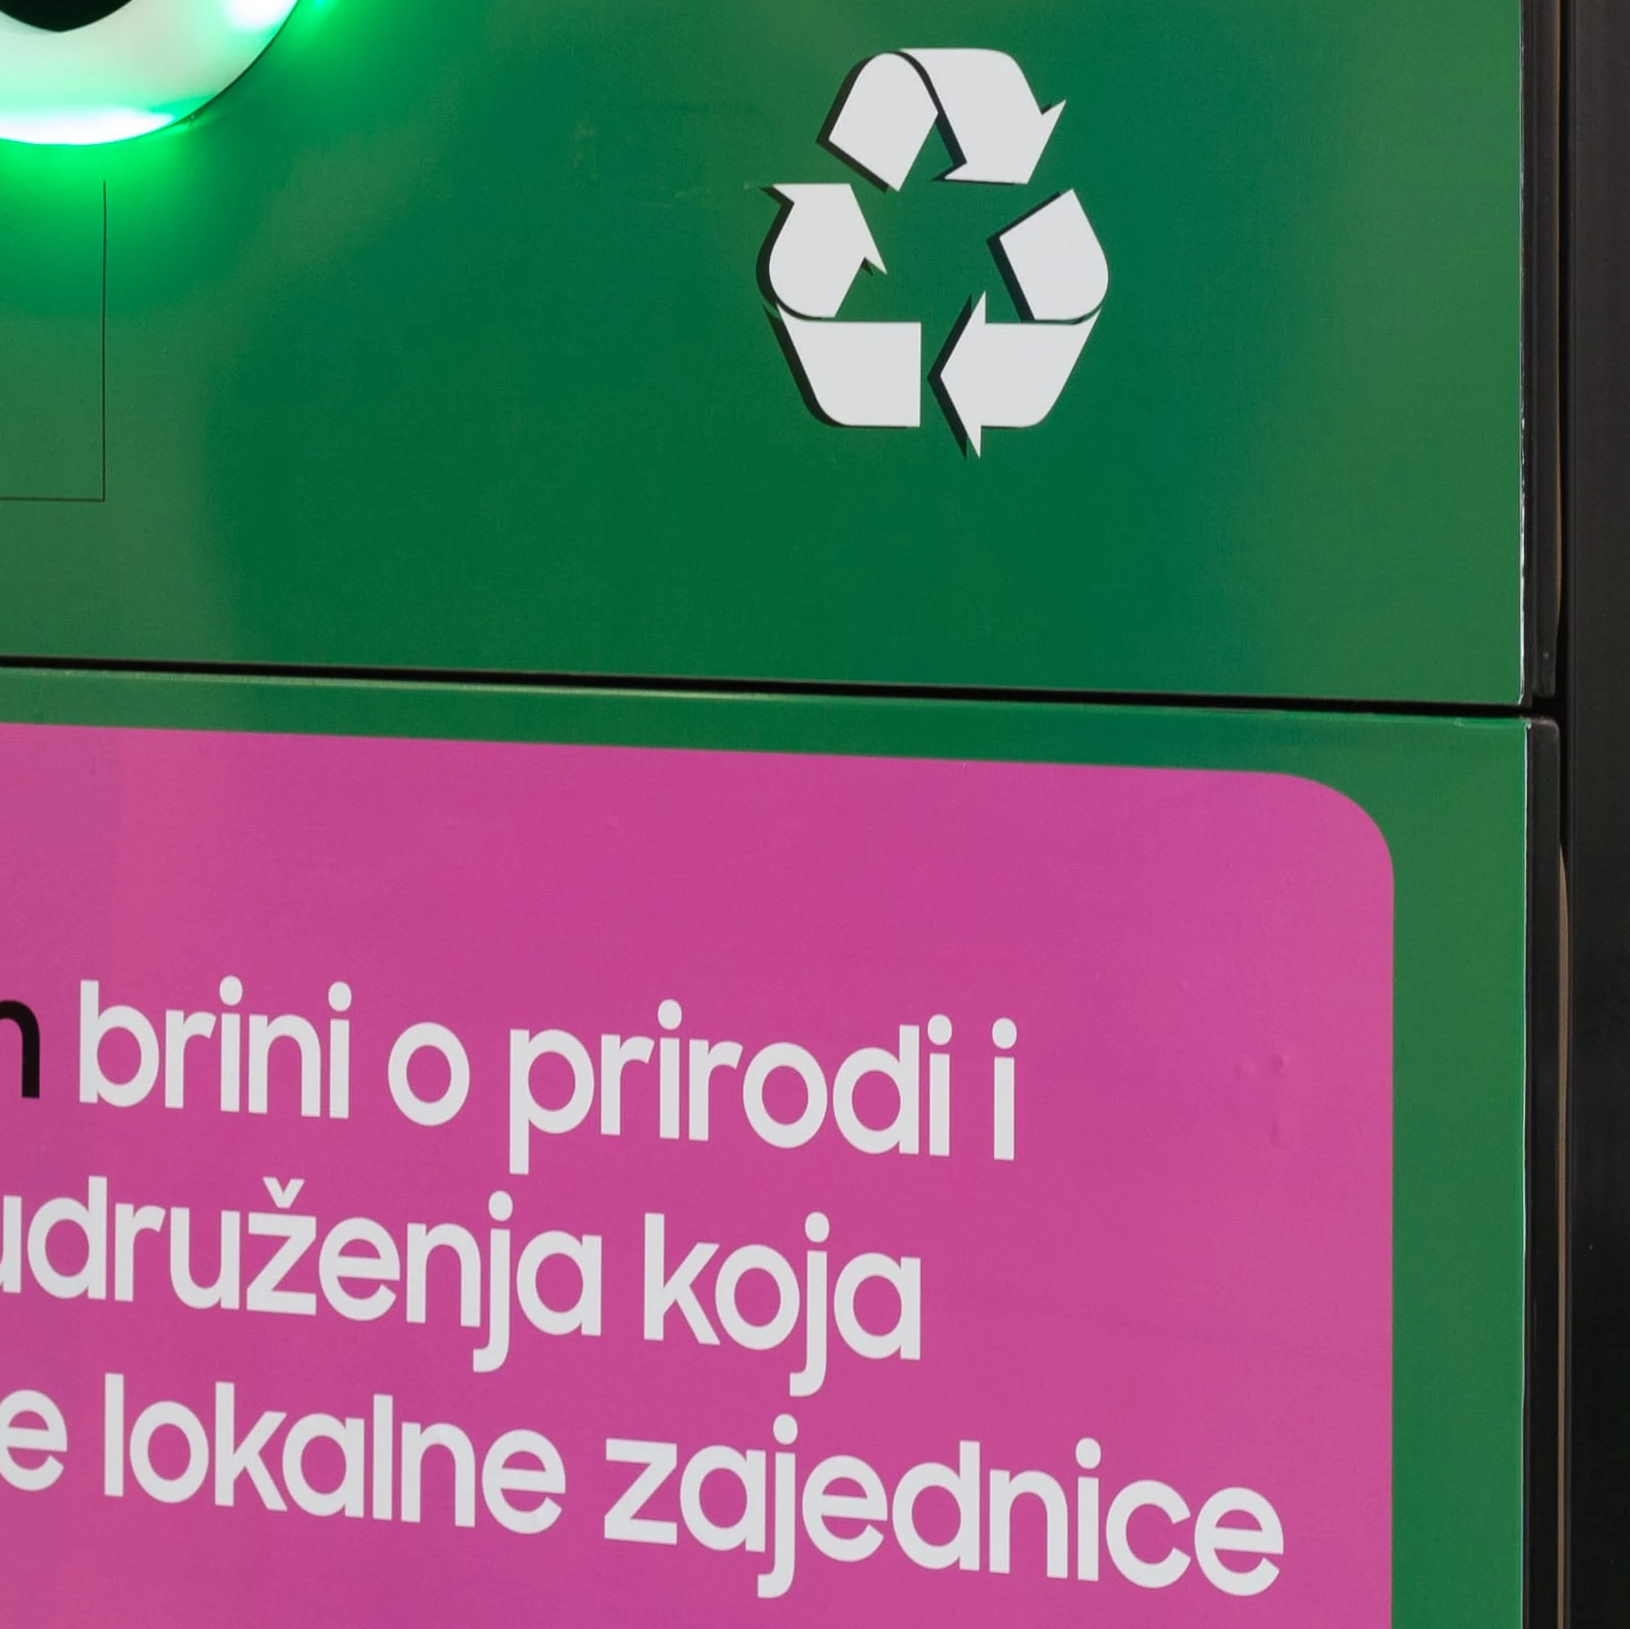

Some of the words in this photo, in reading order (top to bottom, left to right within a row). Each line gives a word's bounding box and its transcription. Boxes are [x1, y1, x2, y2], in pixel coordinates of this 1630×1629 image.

[78, 976, 351, 1120] brini
[387, 1021, 470, 1127] o
[509, 1000, 951, 1176] prirodi
[991, 1017, 1018, 1162] i
[643, 1212, 922, 1397] koja
[103, 1372, 567, 1534] lokalne
[604, 1414, 1285, 1598] zajednice
